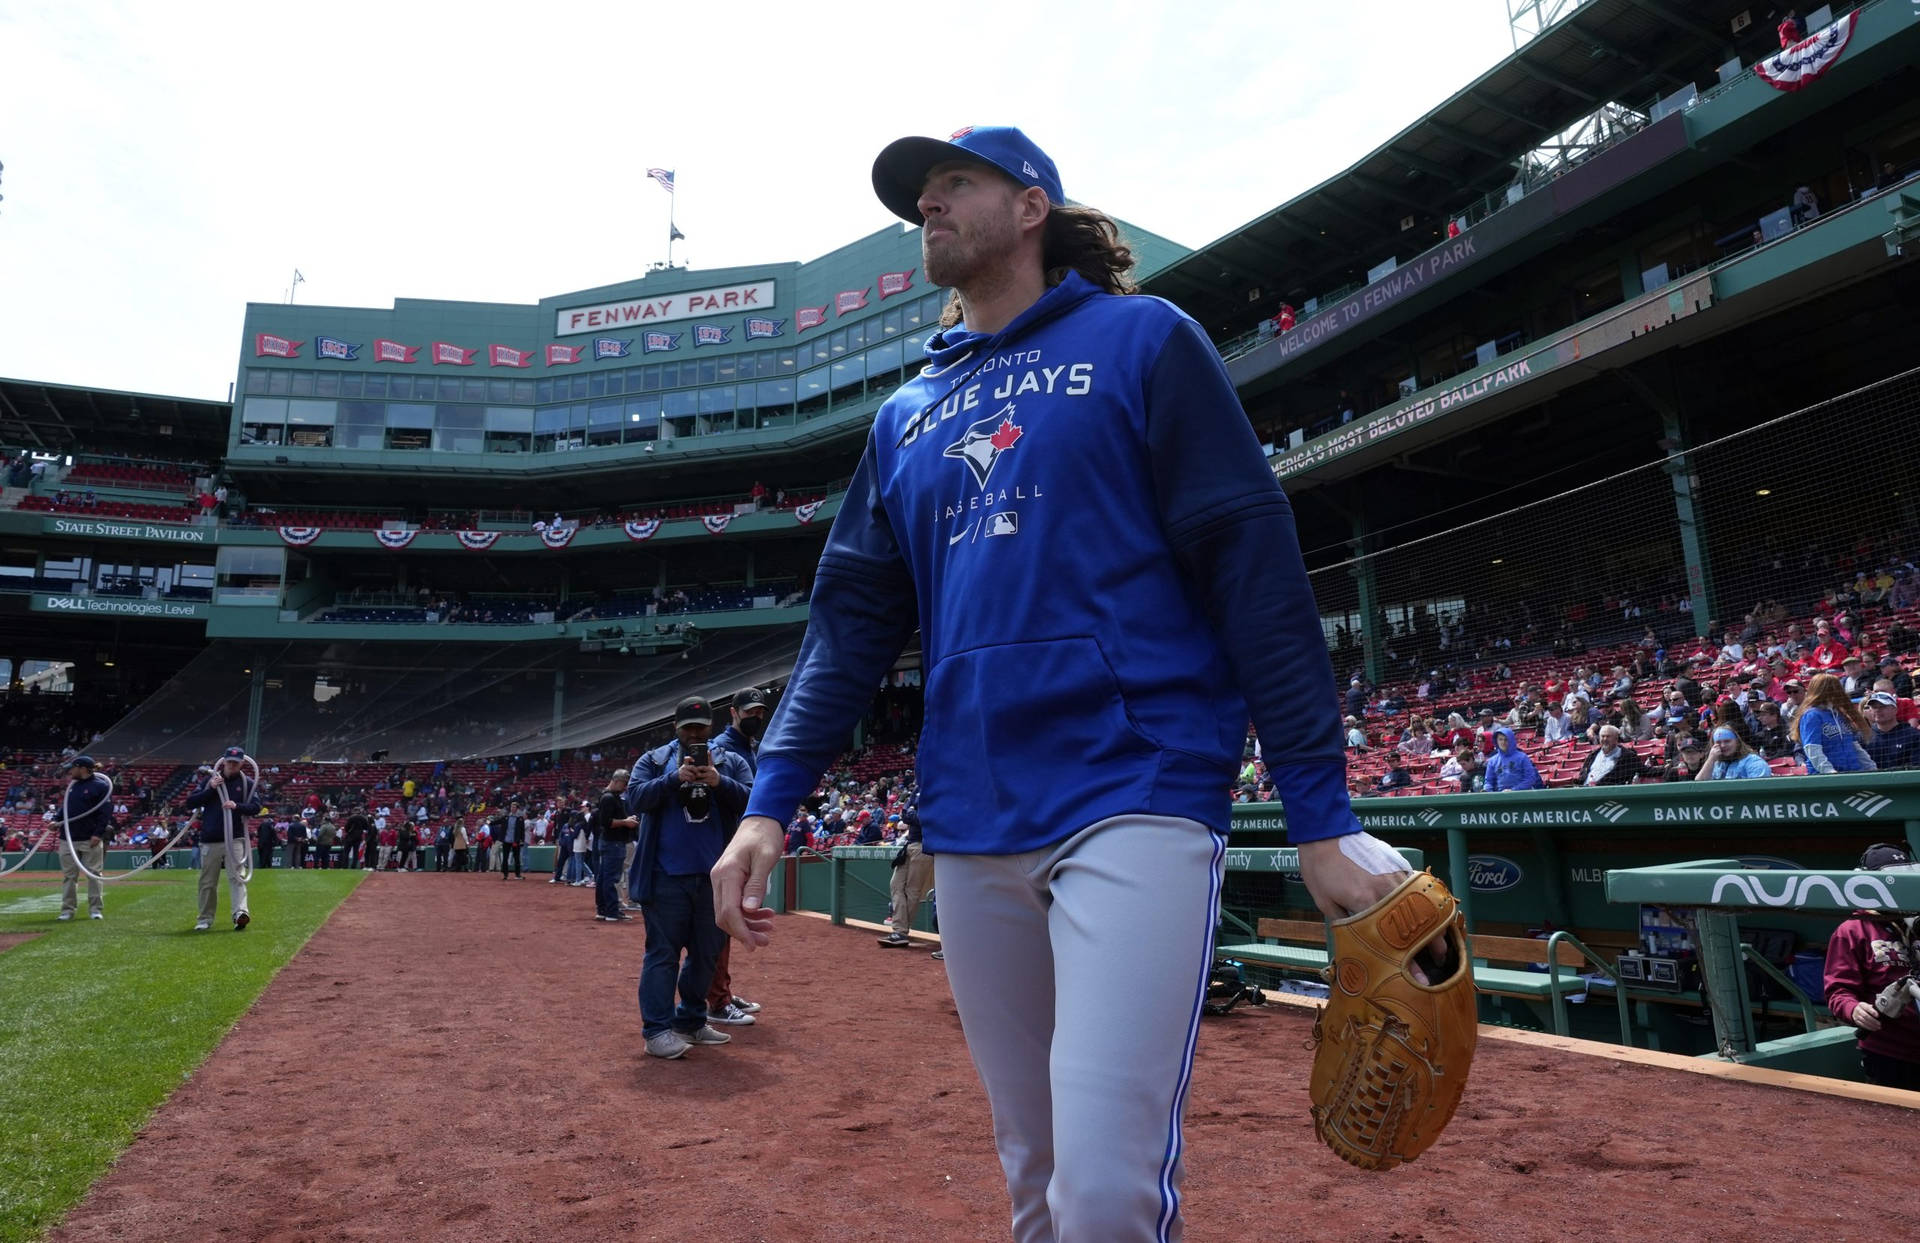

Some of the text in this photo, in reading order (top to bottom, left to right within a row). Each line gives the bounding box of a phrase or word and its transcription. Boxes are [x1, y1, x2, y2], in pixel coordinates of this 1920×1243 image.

[1280, 236, 1476, 357] WELCOME TO FENWAY PARK
[570, 288, 758, 329] FENWAY PARK
[994, 363, 1093, 400] JAYS
[1271, 360, 1531, 478] MERICA'S MOST BELOVED BALLPARK
[55, 520, 204, 542] STATE STREET PAVILION
[48, 597, 195, 616] DELL Technologies Level
[1363, 815, 1416, 827] AMERICA
[1460, 809, 1592, 825] BANK OF AMERICA
[1654, 802, 1840, 822] BANK OF AMERICA
[1230, 818, 1284, 830] OF AMERICA
[1224, 850, 1300, 871] finity xfinit
